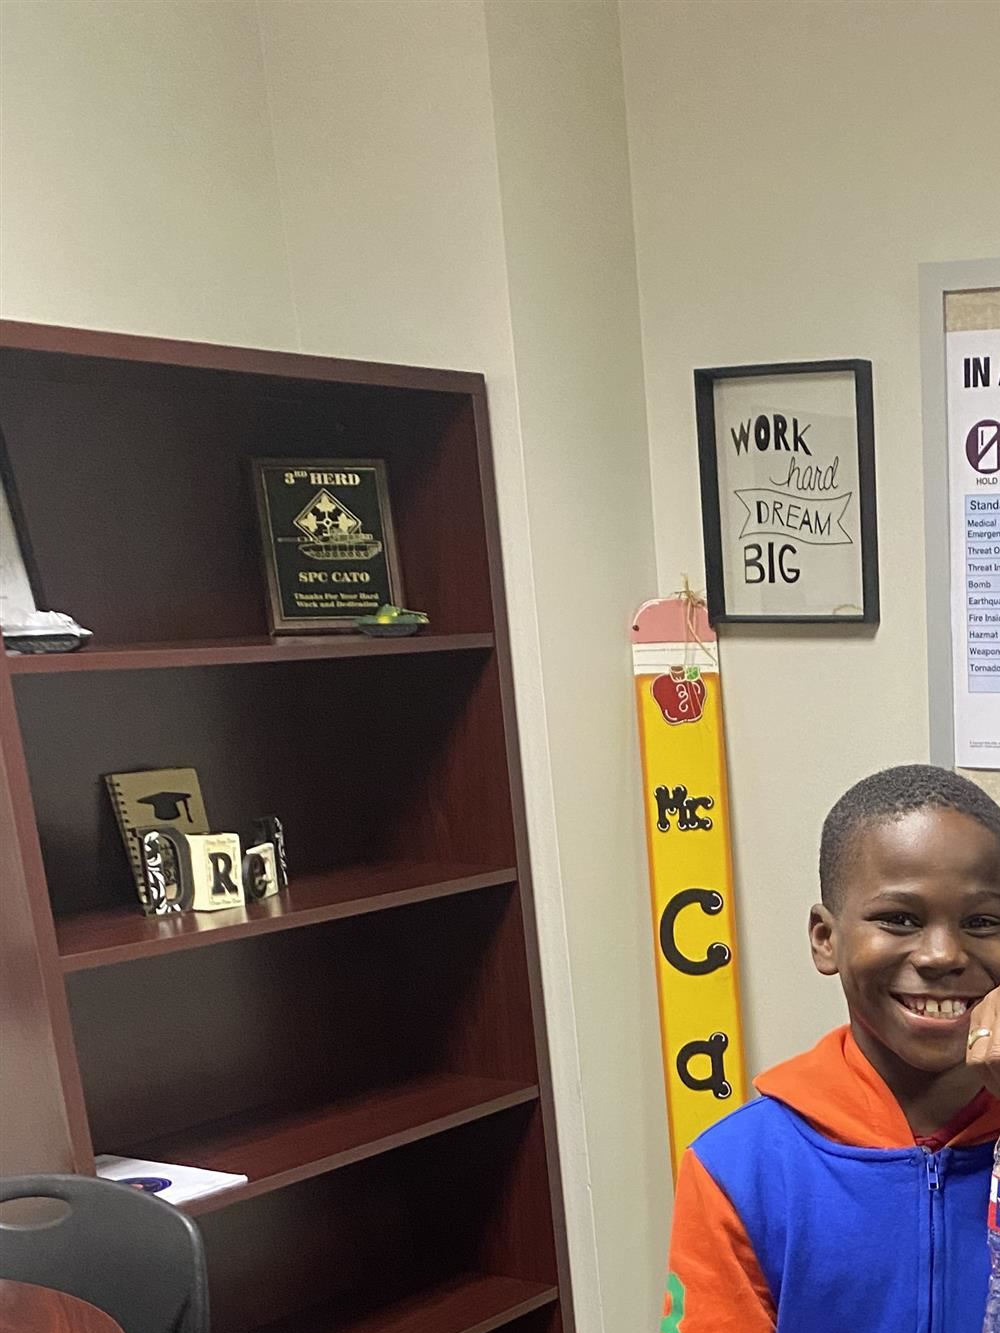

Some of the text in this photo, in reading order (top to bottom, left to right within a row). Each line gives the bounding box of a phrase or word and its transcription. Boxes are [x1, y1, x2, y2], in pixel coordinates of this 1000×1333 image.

[963, 356, 990, 388] IN
[730, 413, 812, 456] WORK
[769, 456, 839, 491] hard
[310, 473, 360, 485] HERD
[976, 477, 998, 486] HOLD
[756, 500, 832, 536] DREAM
[967, 519, 997, 528] Medical
[968, 546, 992, 555] Threat
[744, 542, 800, 584] BIG
[968, 563, 992, 571] Threat
[298, 571, 370, 583] SPC CATO
[968, 580, 991, 589] Bomb
[969, 614, 983, 622] Fire
[969, 631, 998, 639] Hazmat
[969, 648, 1000, 656] Weapon
